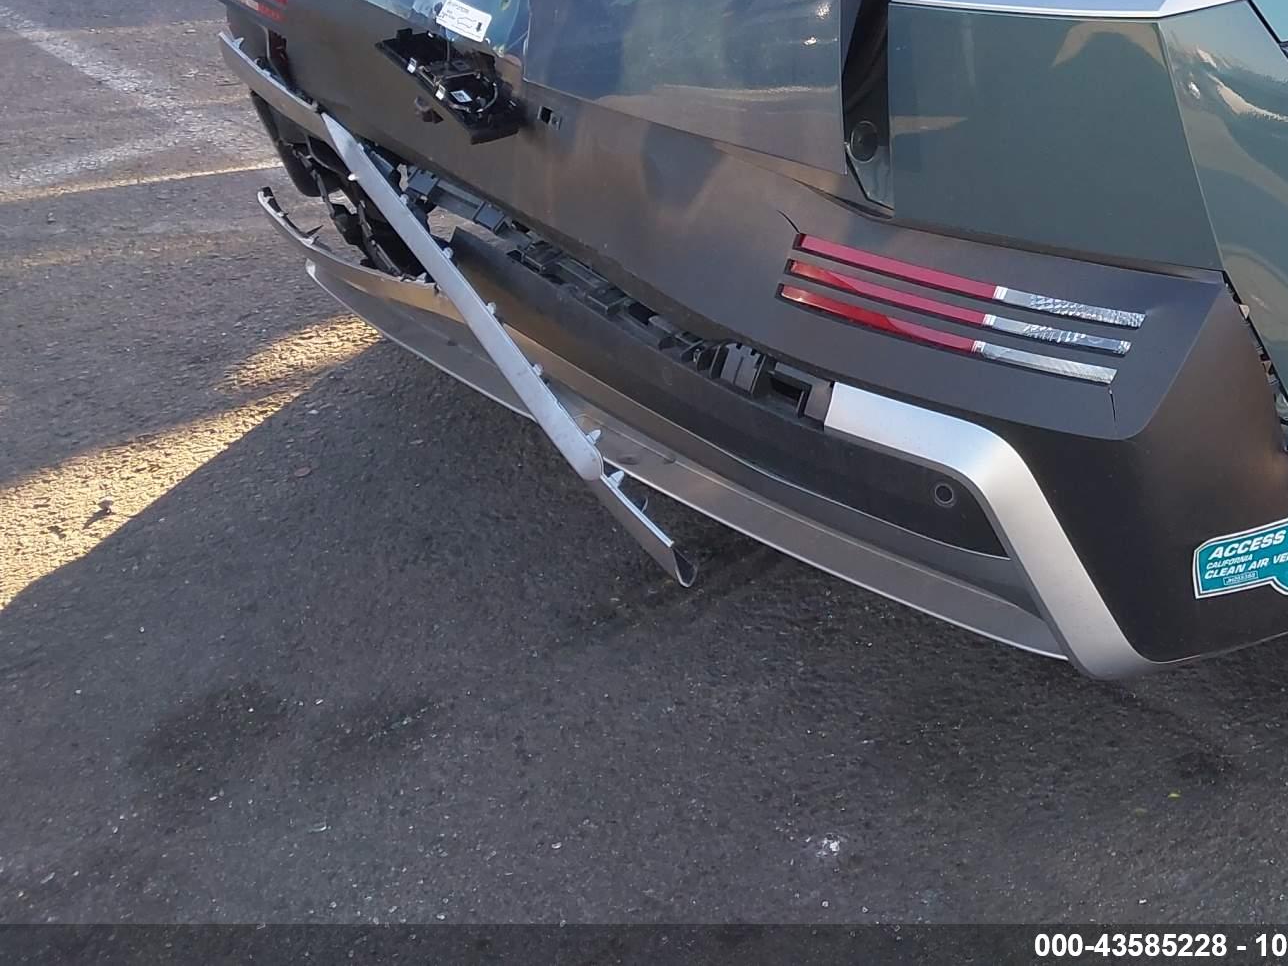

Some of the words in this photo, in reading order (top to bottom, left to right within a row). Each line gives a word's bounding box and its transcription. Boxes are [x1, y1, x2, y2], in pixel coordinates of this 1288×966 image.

[1208, 530, 1286, 560] ACCESS
[1204, 564, 1246, 580] CLEAN
[1248, 557, 1270, 571] AIR
[1206, 554, 1253, 570] CALIFORNIA
